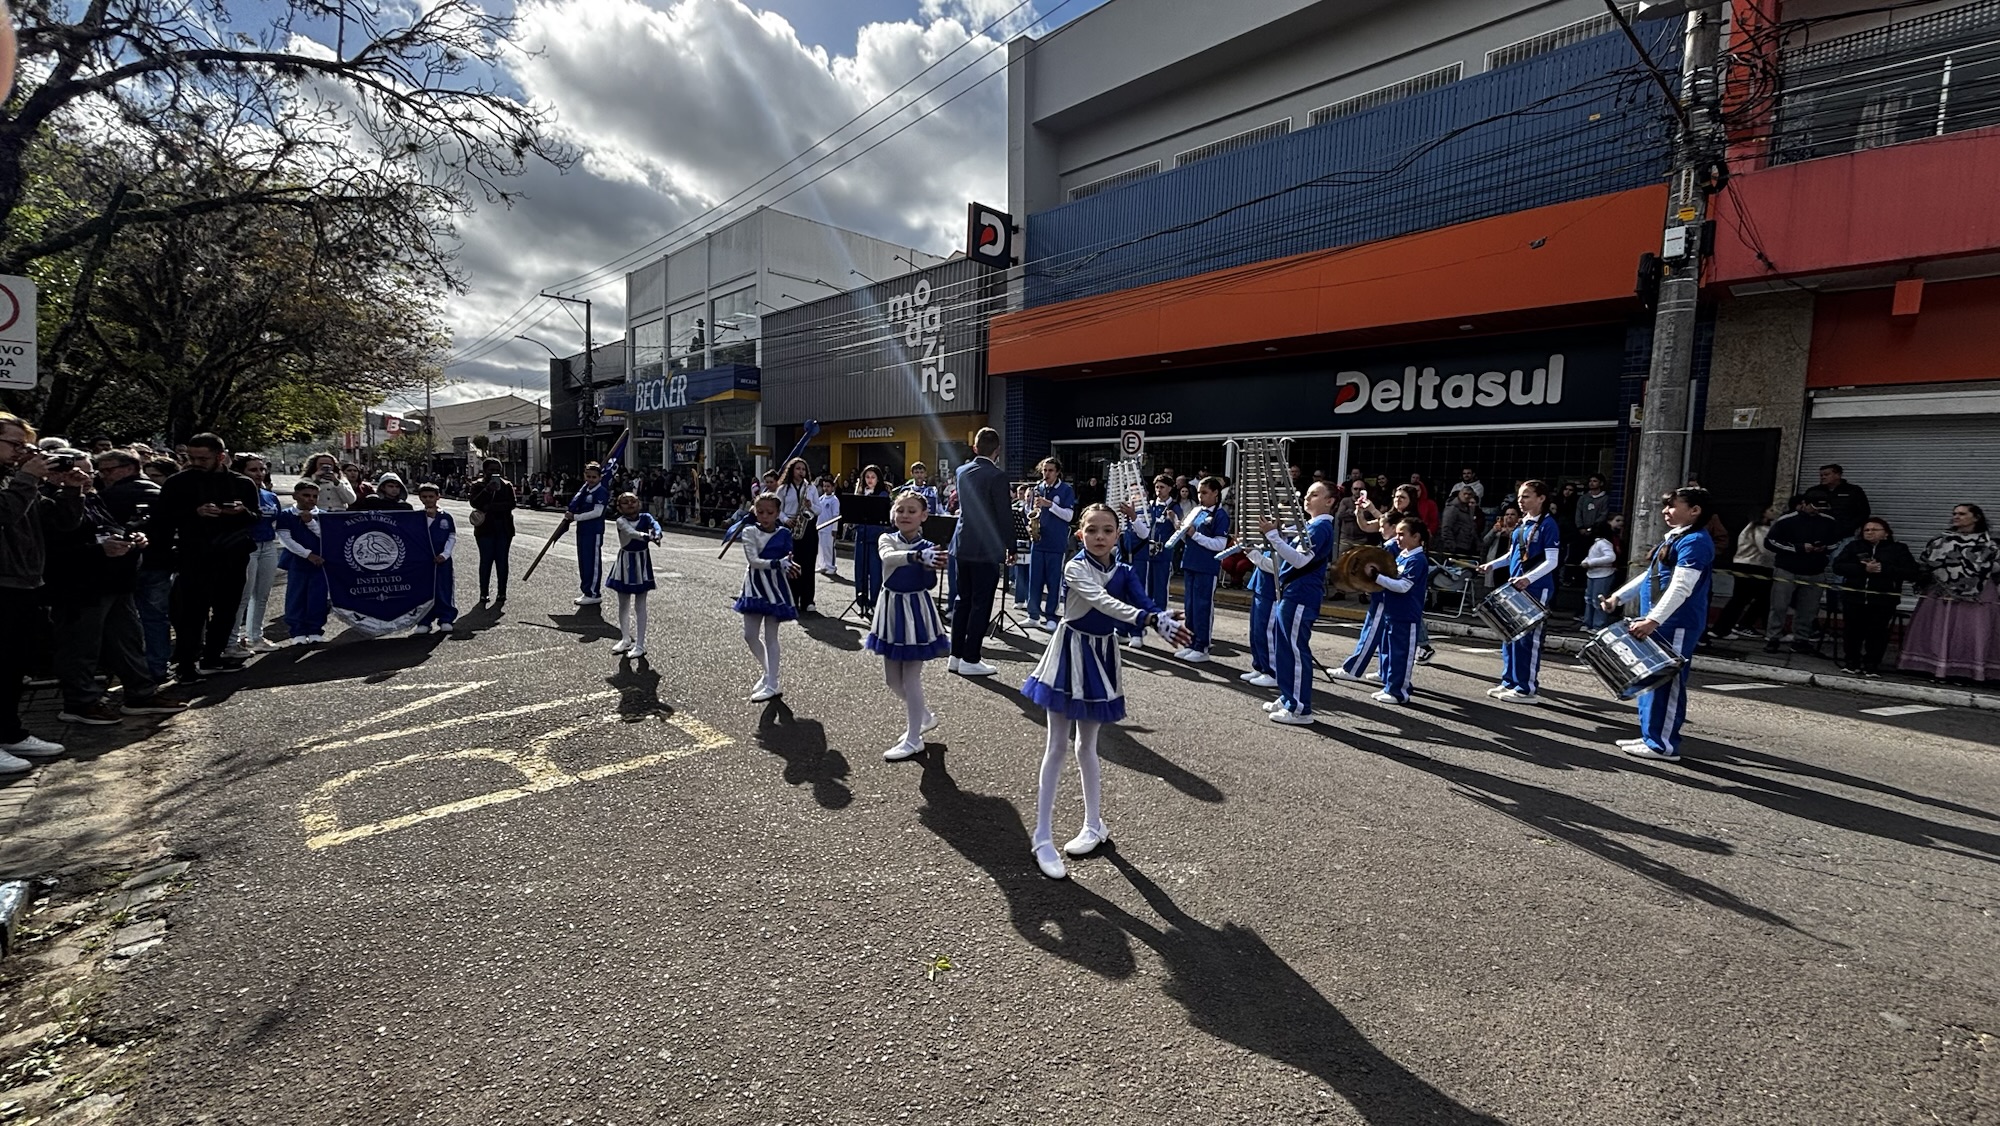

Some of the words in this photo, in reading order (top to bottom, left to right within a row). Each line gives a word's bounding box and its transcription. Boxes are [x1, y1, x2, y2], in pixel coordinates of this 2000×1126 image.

[1334, 354, 1564, 413] Deltasul
[635, 371, 688, 412] BECKER
[1076, 415, 1094, 428] viva
[1096, 413, 1119, 427] mais
[1121, 415, 1127, 426] a
[1129, 413, 1147, 426] sua
[1149, 412, 1173, 424] casa
[848, 426, 895, 439] modazine
[1127, 436, 1136, 449] E
[345, 515, 369, 526] BANDA
[371, 515, 398, 526] MARCIAL
[356, 575, 402, 585] INSTITUTO
[349, 583, 412, 595] QUERO-QUERO
